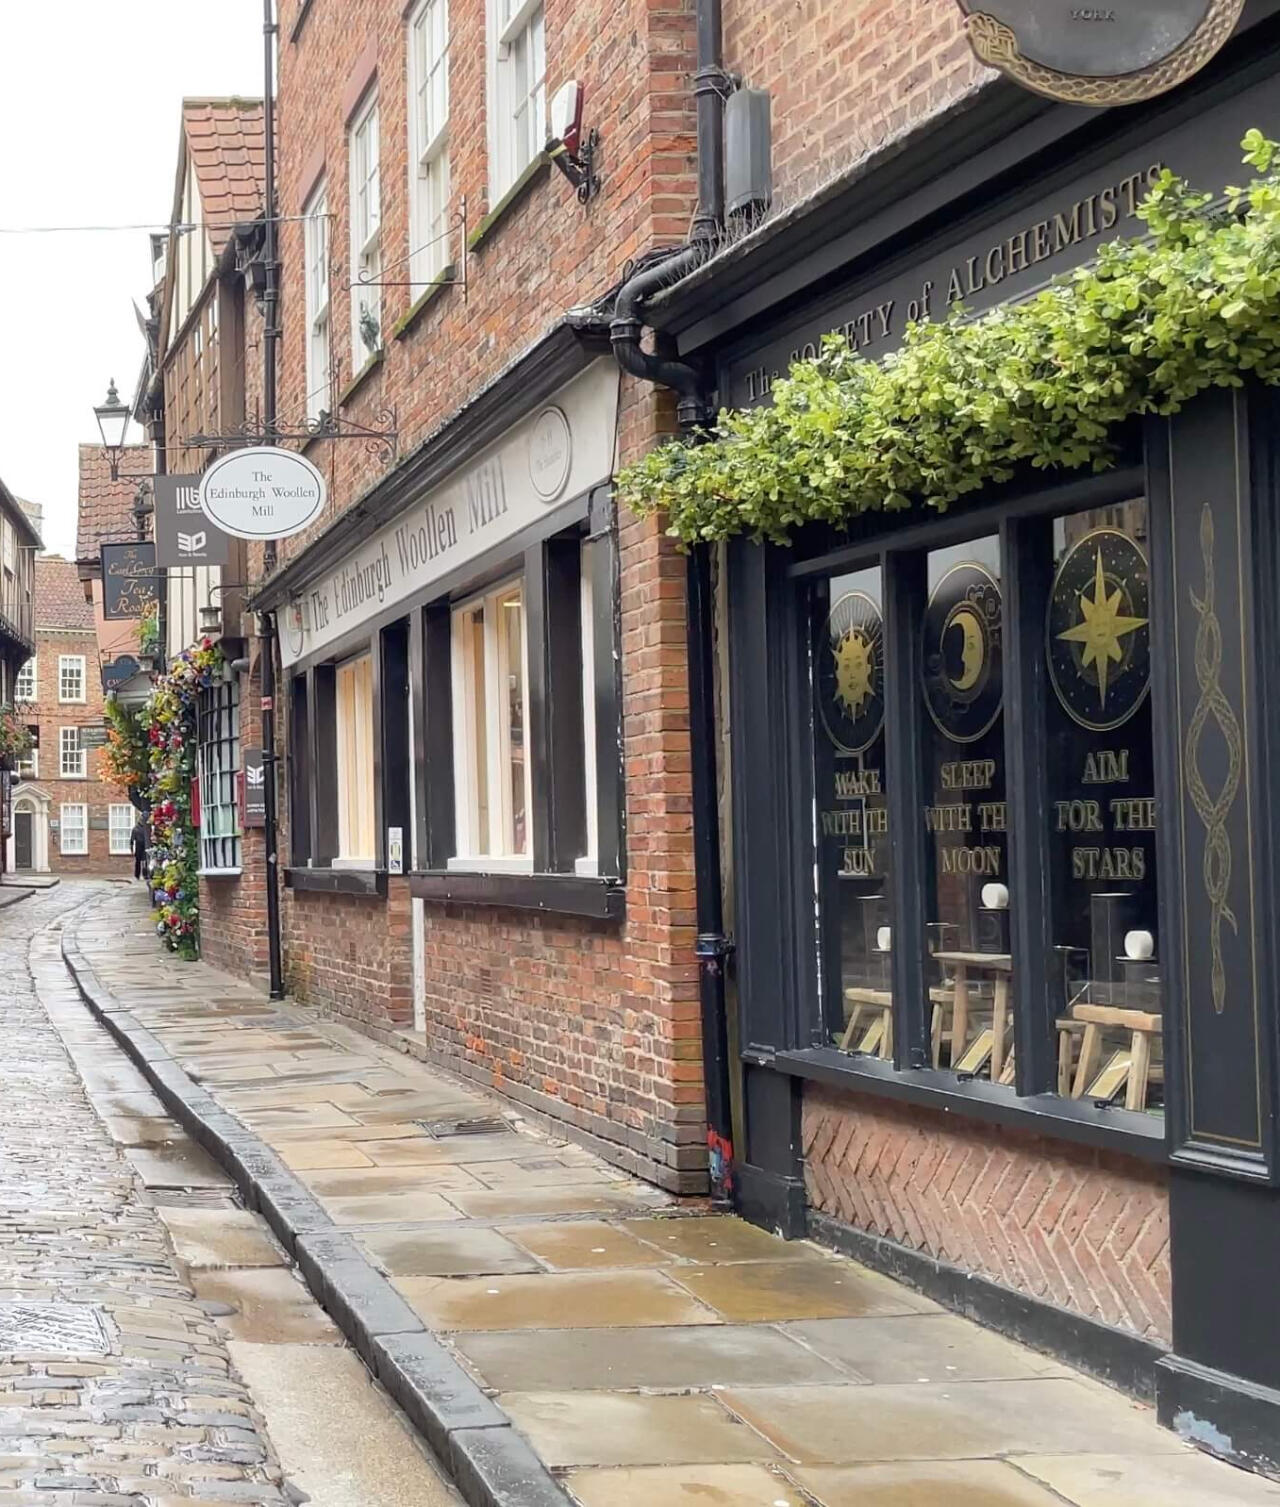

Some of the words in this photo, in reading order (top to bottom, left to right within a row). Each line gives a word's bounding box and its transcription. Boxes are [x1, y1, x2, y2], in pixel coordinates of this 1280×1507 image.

[790, 301, 895, 364] OETY
[907, 281, 932, 323] of
[252, 472, 272, 482] The
[210, 488, 266, 502] Edinburgh
[271, 486, 315, 498] Woollen
[252, 506, 274, 517] Mill
[311, 590, 329, 632] The
[333, 542, 392, 619] Edinburgh
[395, 503, 457, 576] Woollen
[464, 455, 508, 534] Mill
[940, 759, 995, 790] SLEEP
[1081, 749, 1129, 783] AIM
[835, 769, 881, 795] WAKE
[821, 809, 862, 835] WITH
[865, 807, 888, 833] TH
[923, 803, 972, 833] WITH
[977, 802, 1007, 832] TH
[1054, 800, 1103, 831] FOR
[843, 847, 876, 875] SUN
[942, 846, 1001, 876] MOON
[1072, 847, 1145, 880] STARS
